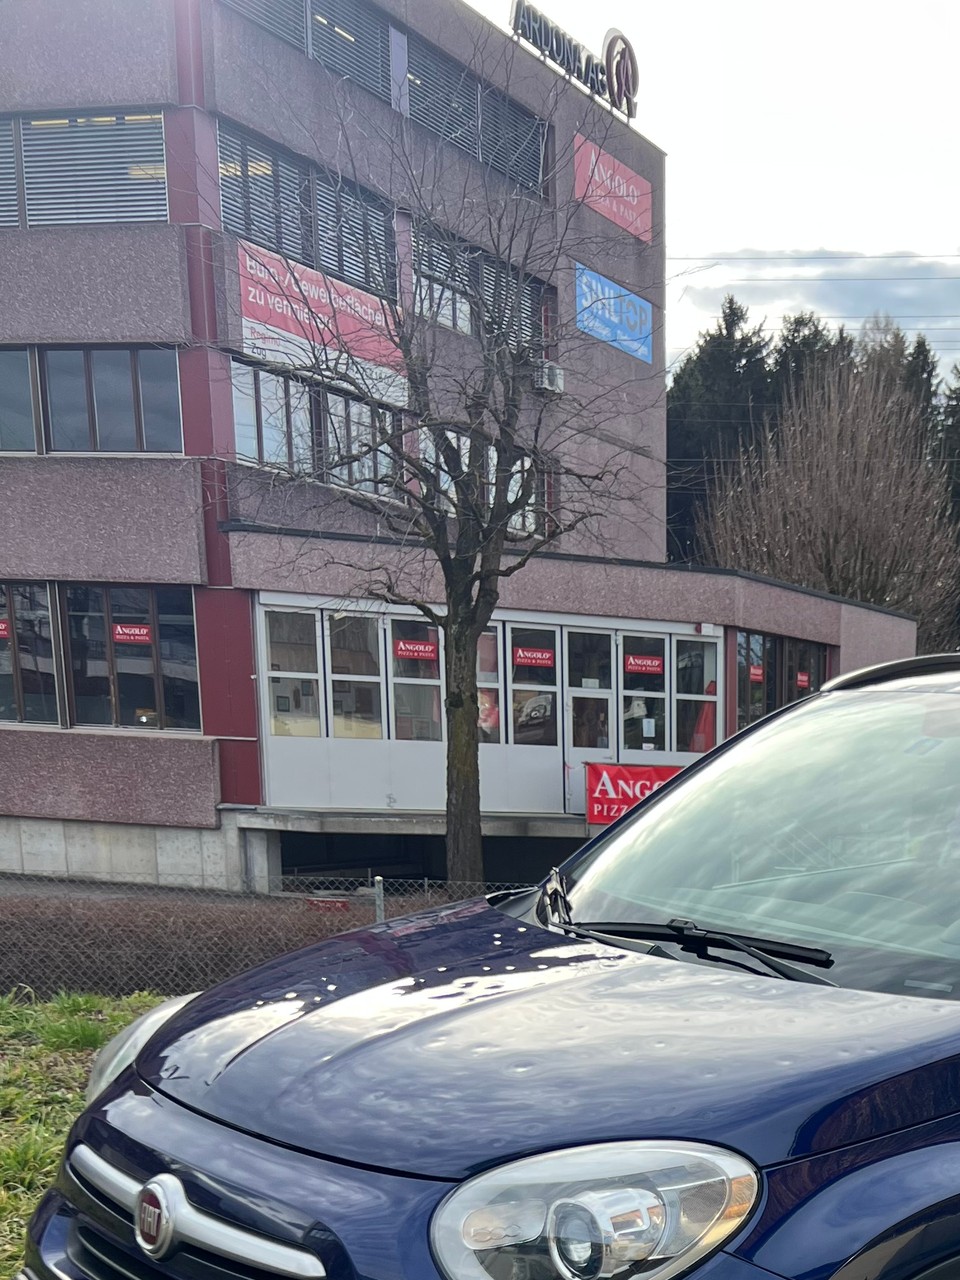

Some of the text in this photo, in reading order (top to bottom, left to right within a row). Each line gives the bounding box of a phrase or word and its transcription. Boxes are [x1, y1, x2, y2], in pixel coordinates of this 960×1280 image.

[514, 0, 584, 84] ARDONA
[248, 286, 265, 306] zu
[115, 625, 147, 635] ANGOLO
[398, 641, 432, 651] ANGOLO
[517, 649, 549, 659] ANGOLO
[628, 656, 658, 666] ANGOLO
[141, 1202, 161, 1237] FIAT
